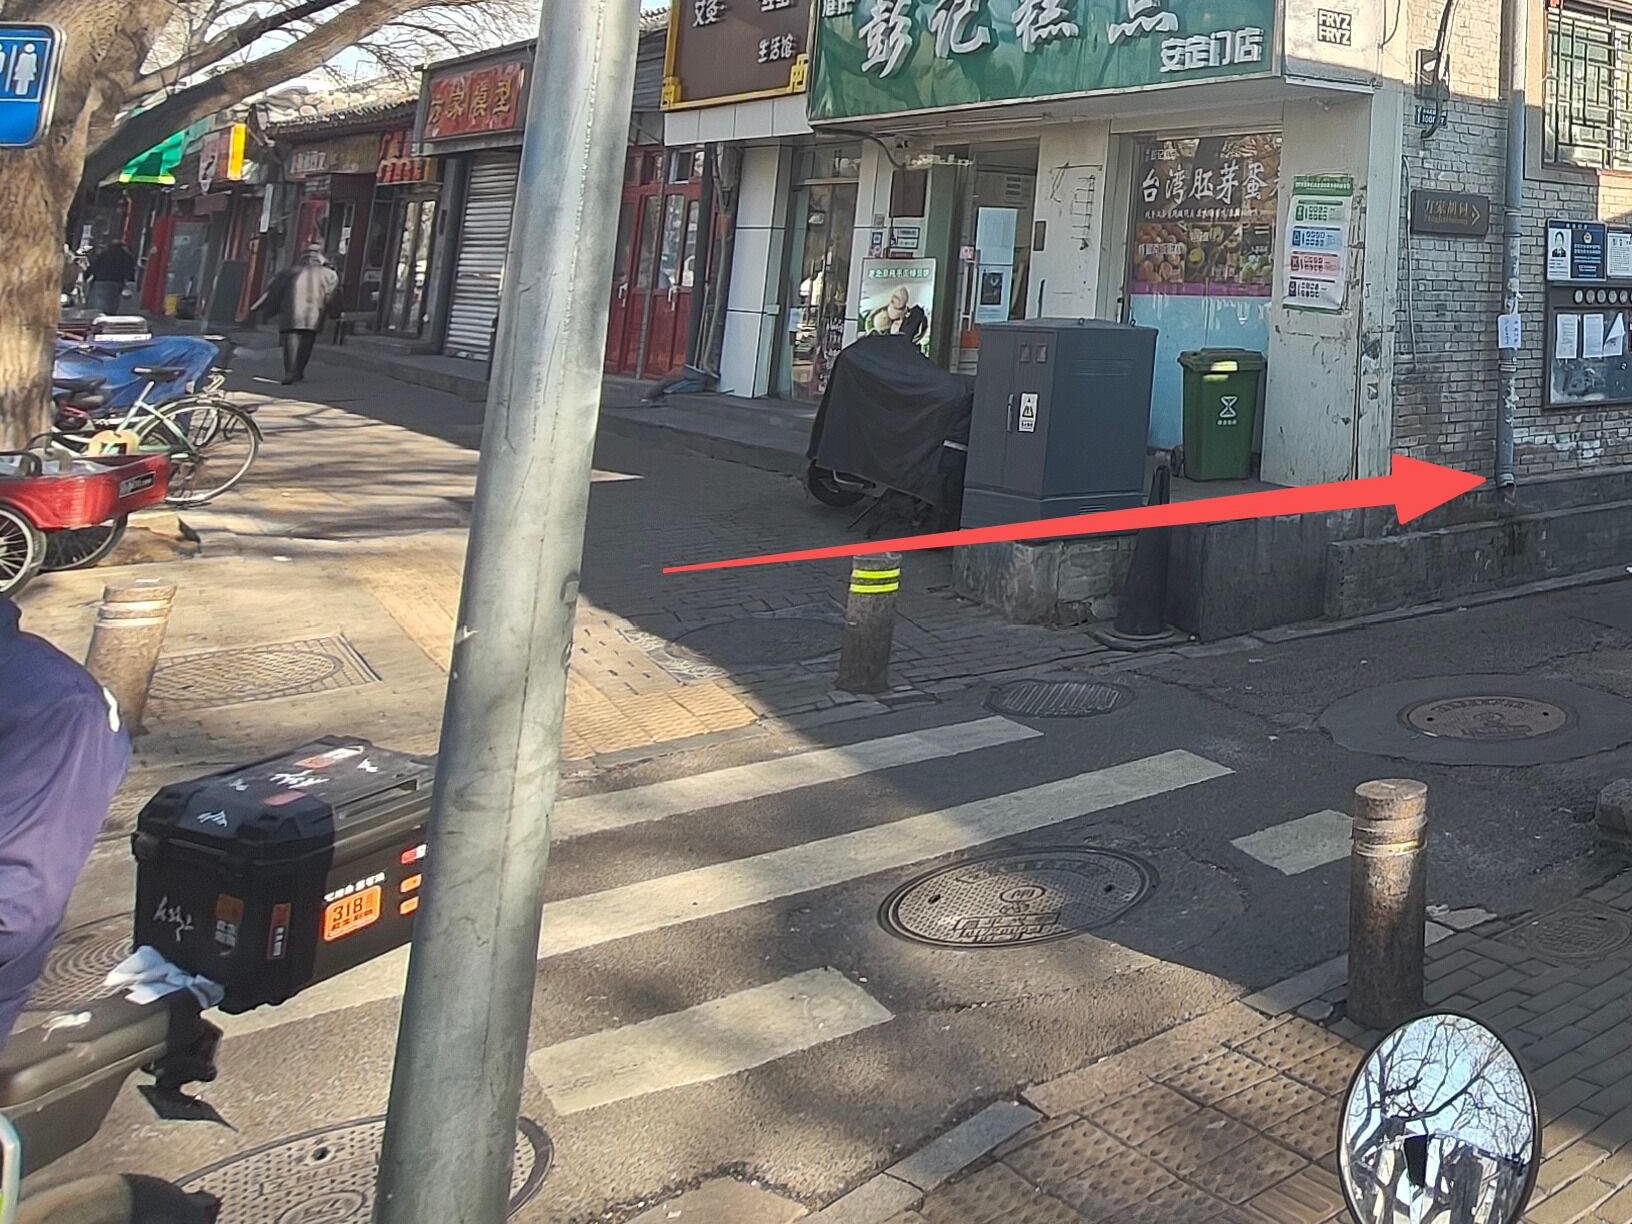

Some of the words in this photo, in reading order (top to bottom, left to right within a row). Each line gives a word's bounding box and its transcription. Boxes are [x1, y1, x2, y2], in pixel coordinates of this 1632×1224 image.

[1319, 10, 1351, 29] FRYZ
[1319, 25, 1351, 45] FRYZ
[757, 33, 797, 64] 生活馆
[1160, 27, 1264, 73] 安定门店
